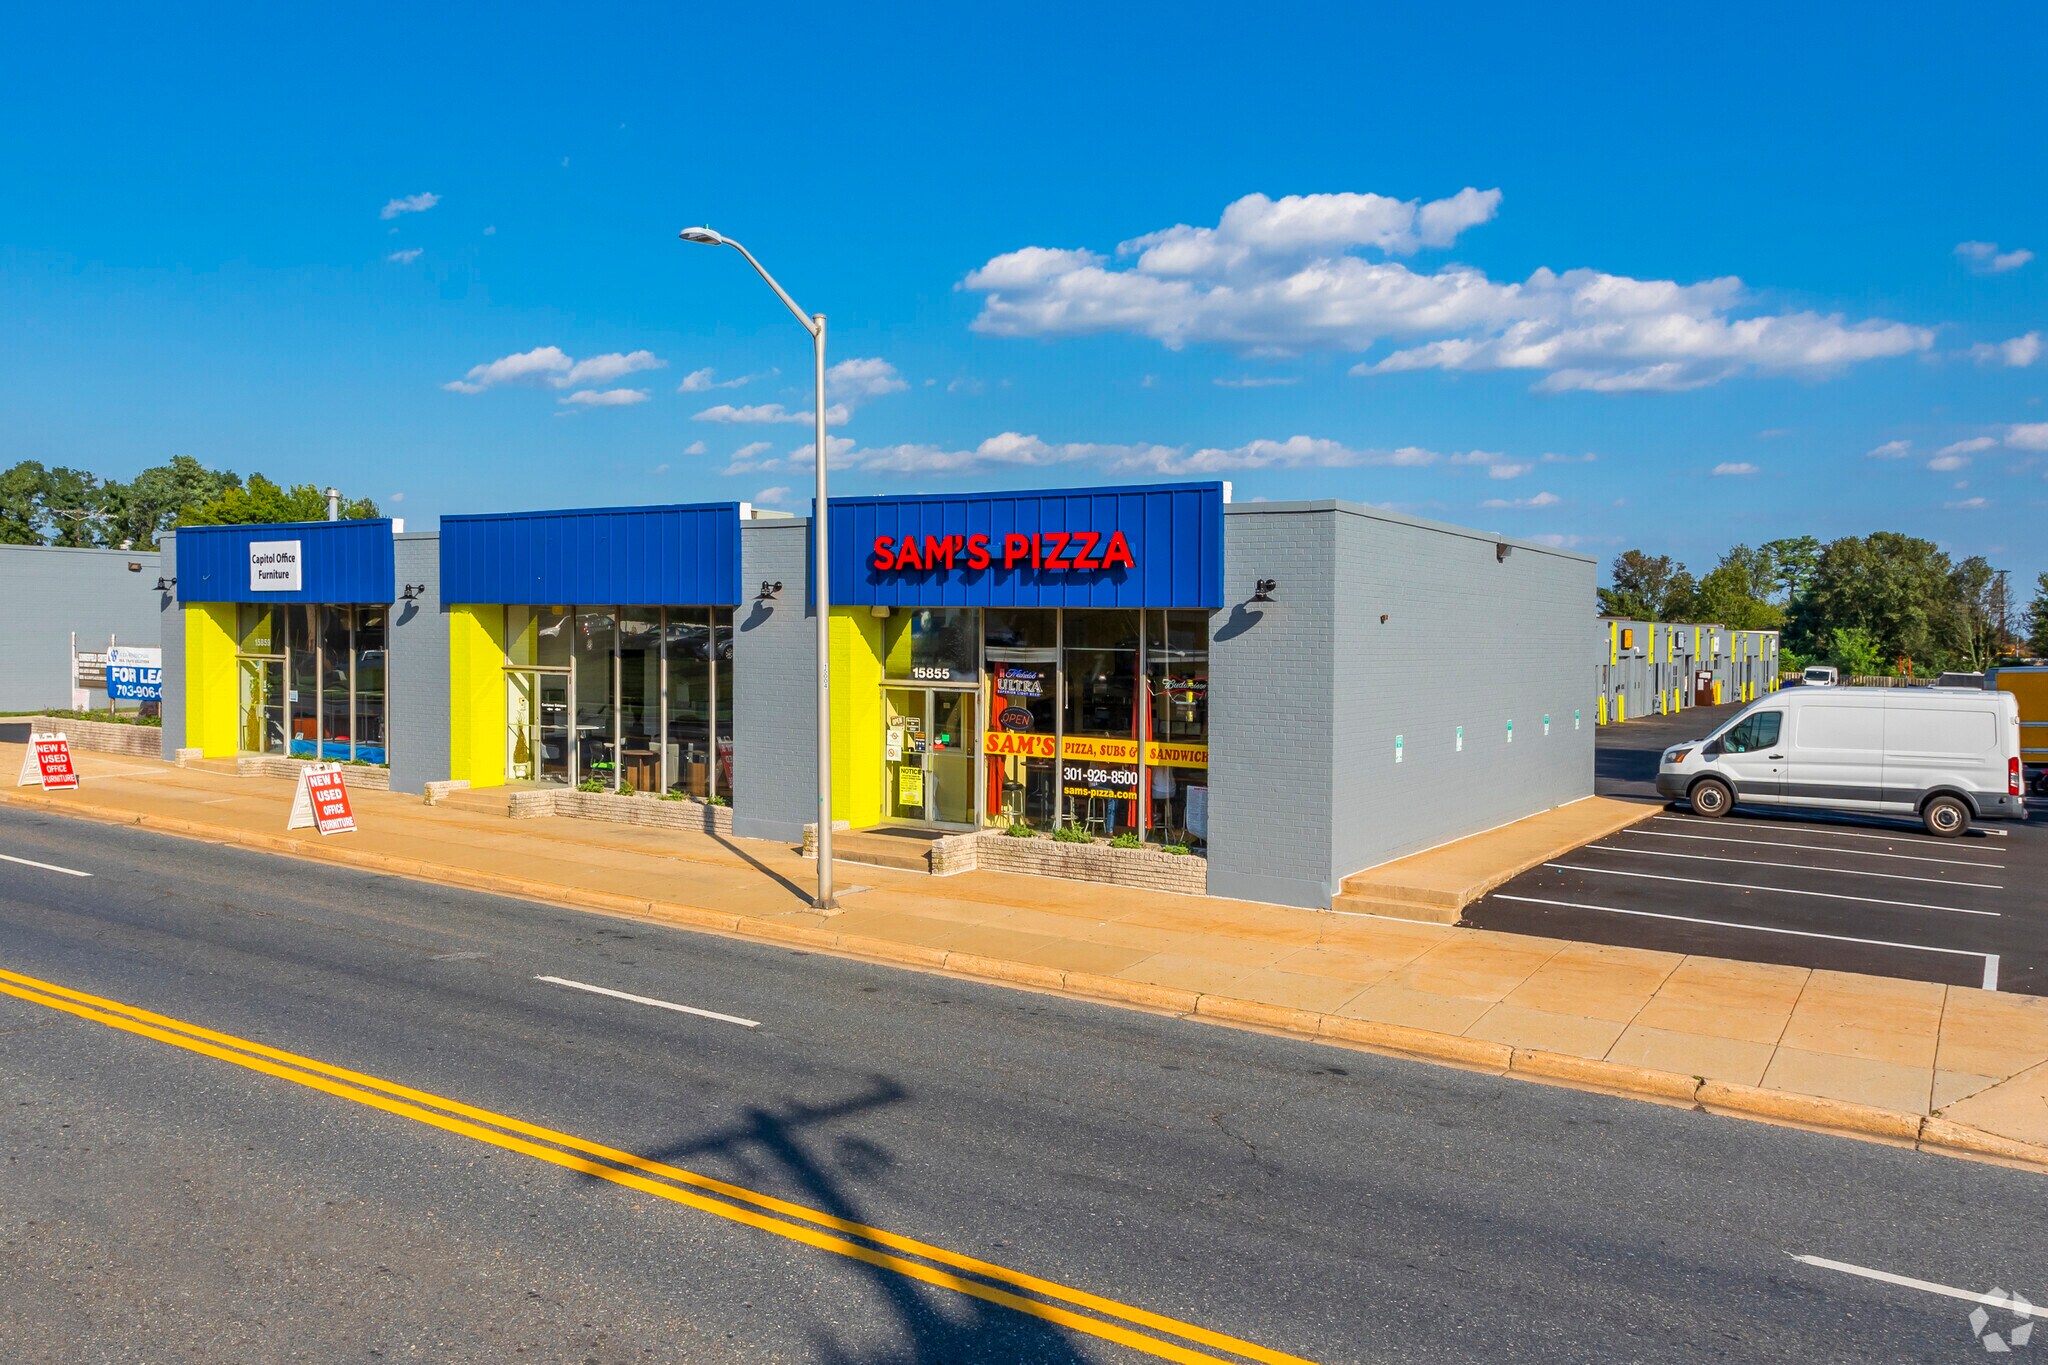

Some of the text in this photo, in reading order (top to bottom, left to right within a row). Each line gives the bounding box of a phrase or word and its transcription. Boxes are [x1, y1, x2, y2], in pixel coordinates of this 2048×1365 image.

[873, 531, 1135, 570] SAM'S PIZZA
[252, 552, 296, 566] Capitol Office
[258, 570, 290, 580] Furniture
[111, 667, 136, 683] FOR
[912, 667, 950, 679] 15855
[1005, 668, 1037, 679] Michelob
[997, 679, 1043, 693] ULTRA
[1002, 712, 1030, 725] OPEN
[36, 743, 67, 753] NEW &
[986, 734, 1055, 756] SAM'S
[1065, 742, 1097, 758] PIZZA,
[1100, 744, 1126, 757] SUBS
[1129, 746, 1138, 757] &
[41, 754, 67, 763] USED
[46, 765, 67, 773] OFFICE
[43, 774, 75, 783] FURNITURE
[309, 773, 342, 787] NEW &
[1063, 767, 1138, 785] 301-926-8500
[316, 789, 343, 802] USED
[1063, 786, 1138, 800] sams-pizza.com
[323, 803, 345, 816] OFFICE
[321, 816, 355, 830] FURNITURE
